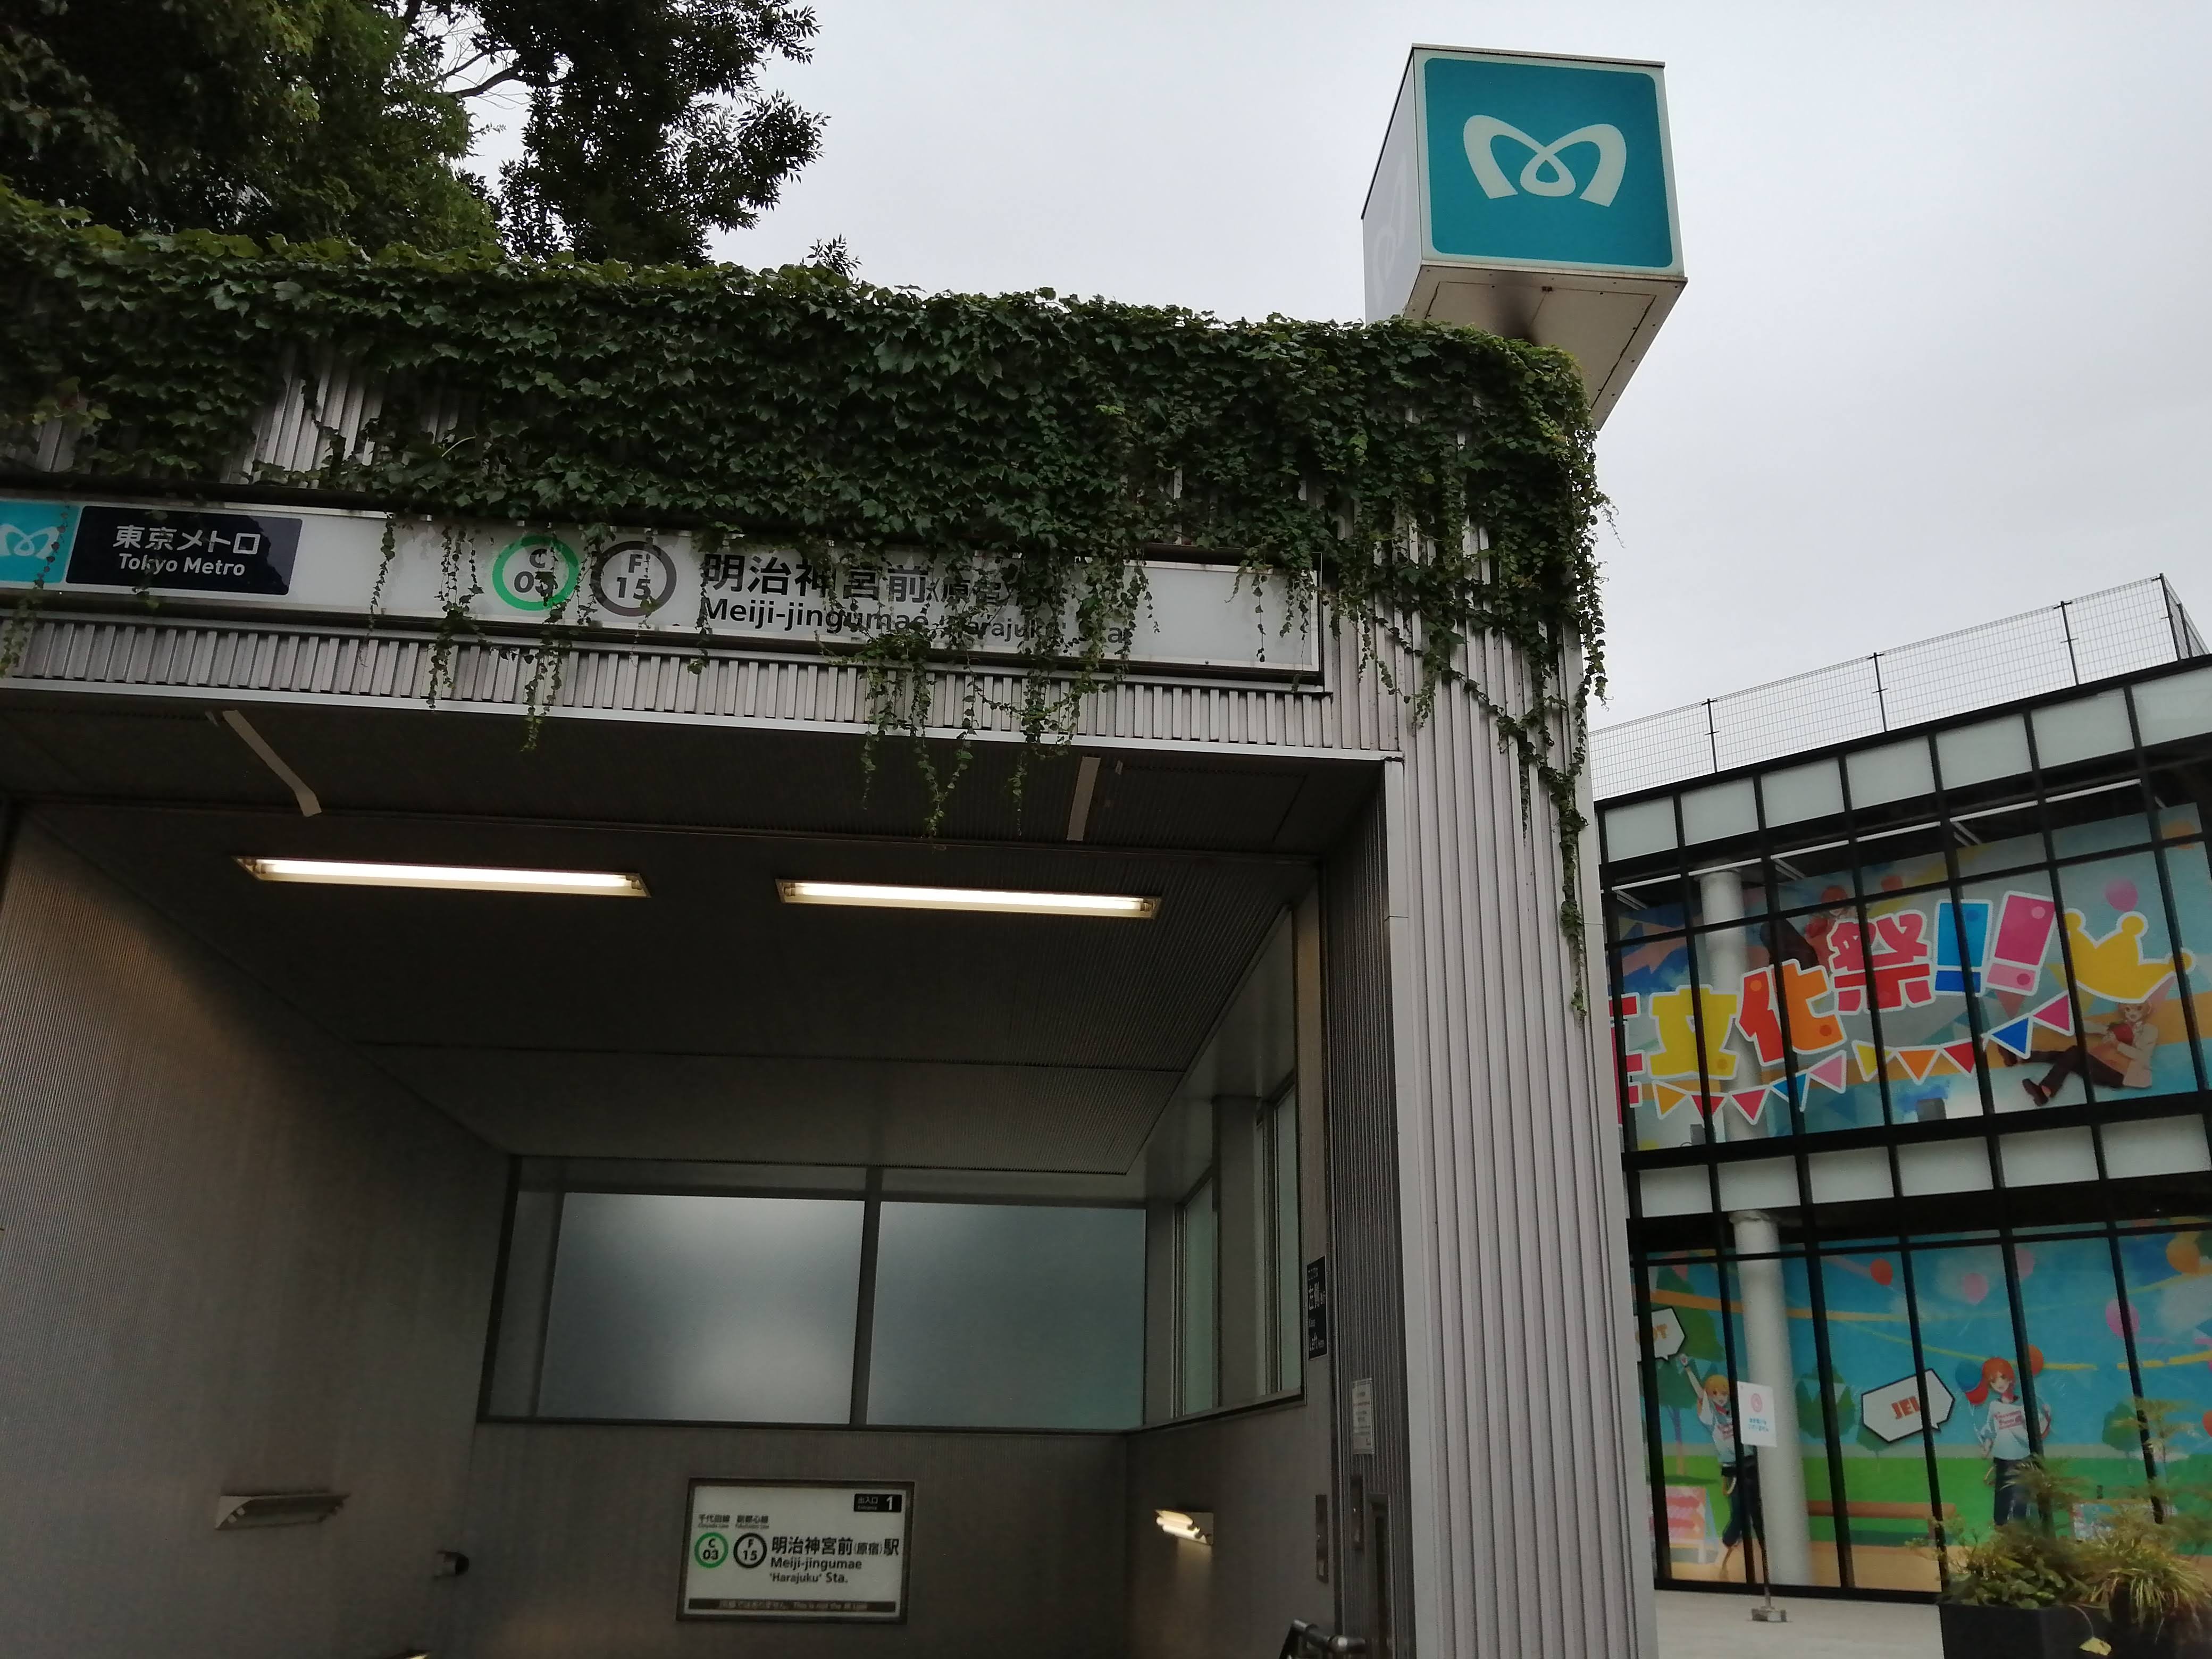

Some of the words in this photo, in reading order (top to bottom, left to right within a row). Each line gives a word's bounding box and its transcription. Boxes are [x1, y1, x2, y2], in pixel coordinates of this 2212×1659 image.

[112, 524, 261, 555] 東京メトロ
[119, 553, 178, 575] Tokyo
[184, 557, 246, 576] Metro
[628, 554, 643, 573] F
[617, 576, 651, 600] 15
[886, 1495, 893, 1511] 1
[708, 1538, 716, 1548] C
[748, 1539, 754, 1548] F
[702, 1549, 718, 1560] 03
[743, 1550, 758, 1561] 15
[771, 1556, 862, 1572] Meiji-jingumae
[825, 1571, 849, 1583] Sta.
